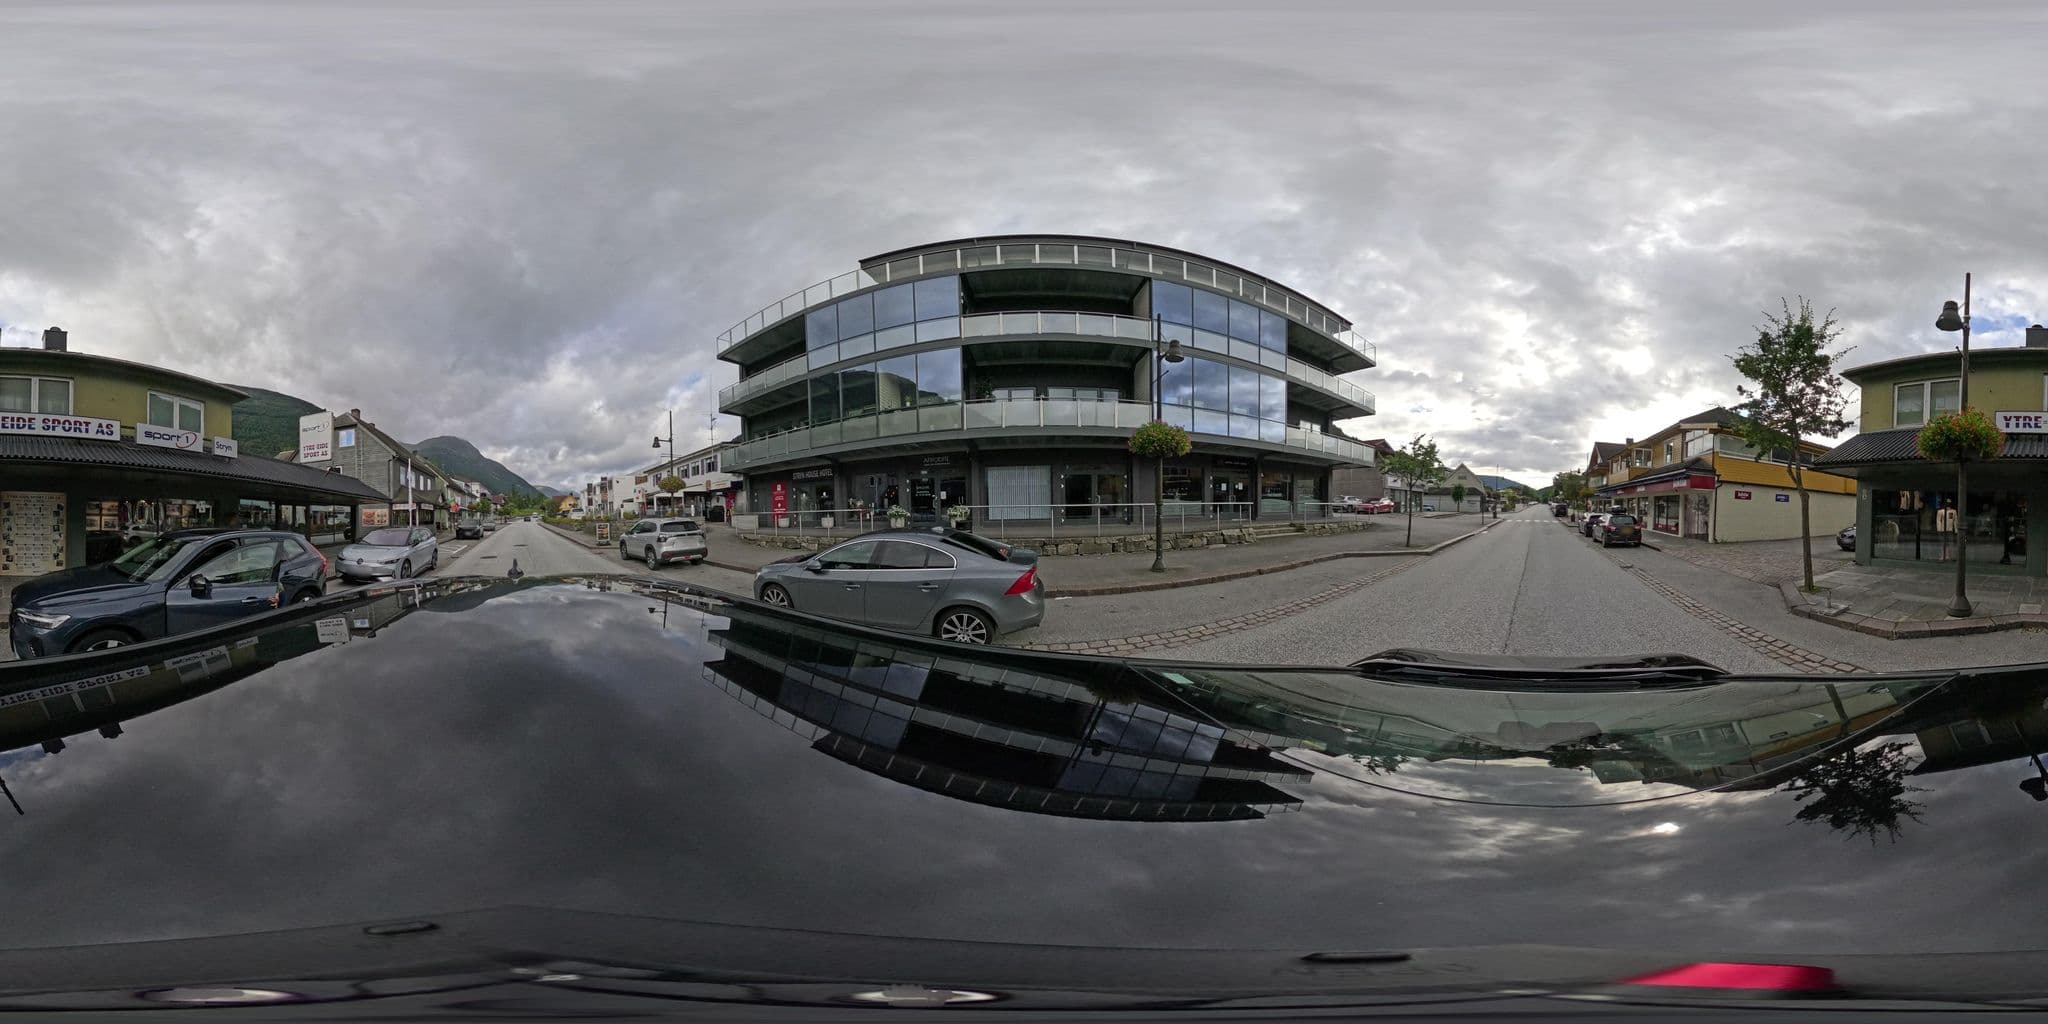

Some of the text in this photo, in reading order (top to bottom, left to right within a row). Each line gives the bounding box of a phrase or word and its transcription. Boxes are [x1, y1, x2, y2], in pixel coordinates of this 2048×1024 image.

[0, 416, 114, 436] EIDE SPORT AS
[144, 430, 181, 442] sport
[215, 441, 232, 452] Stryn
